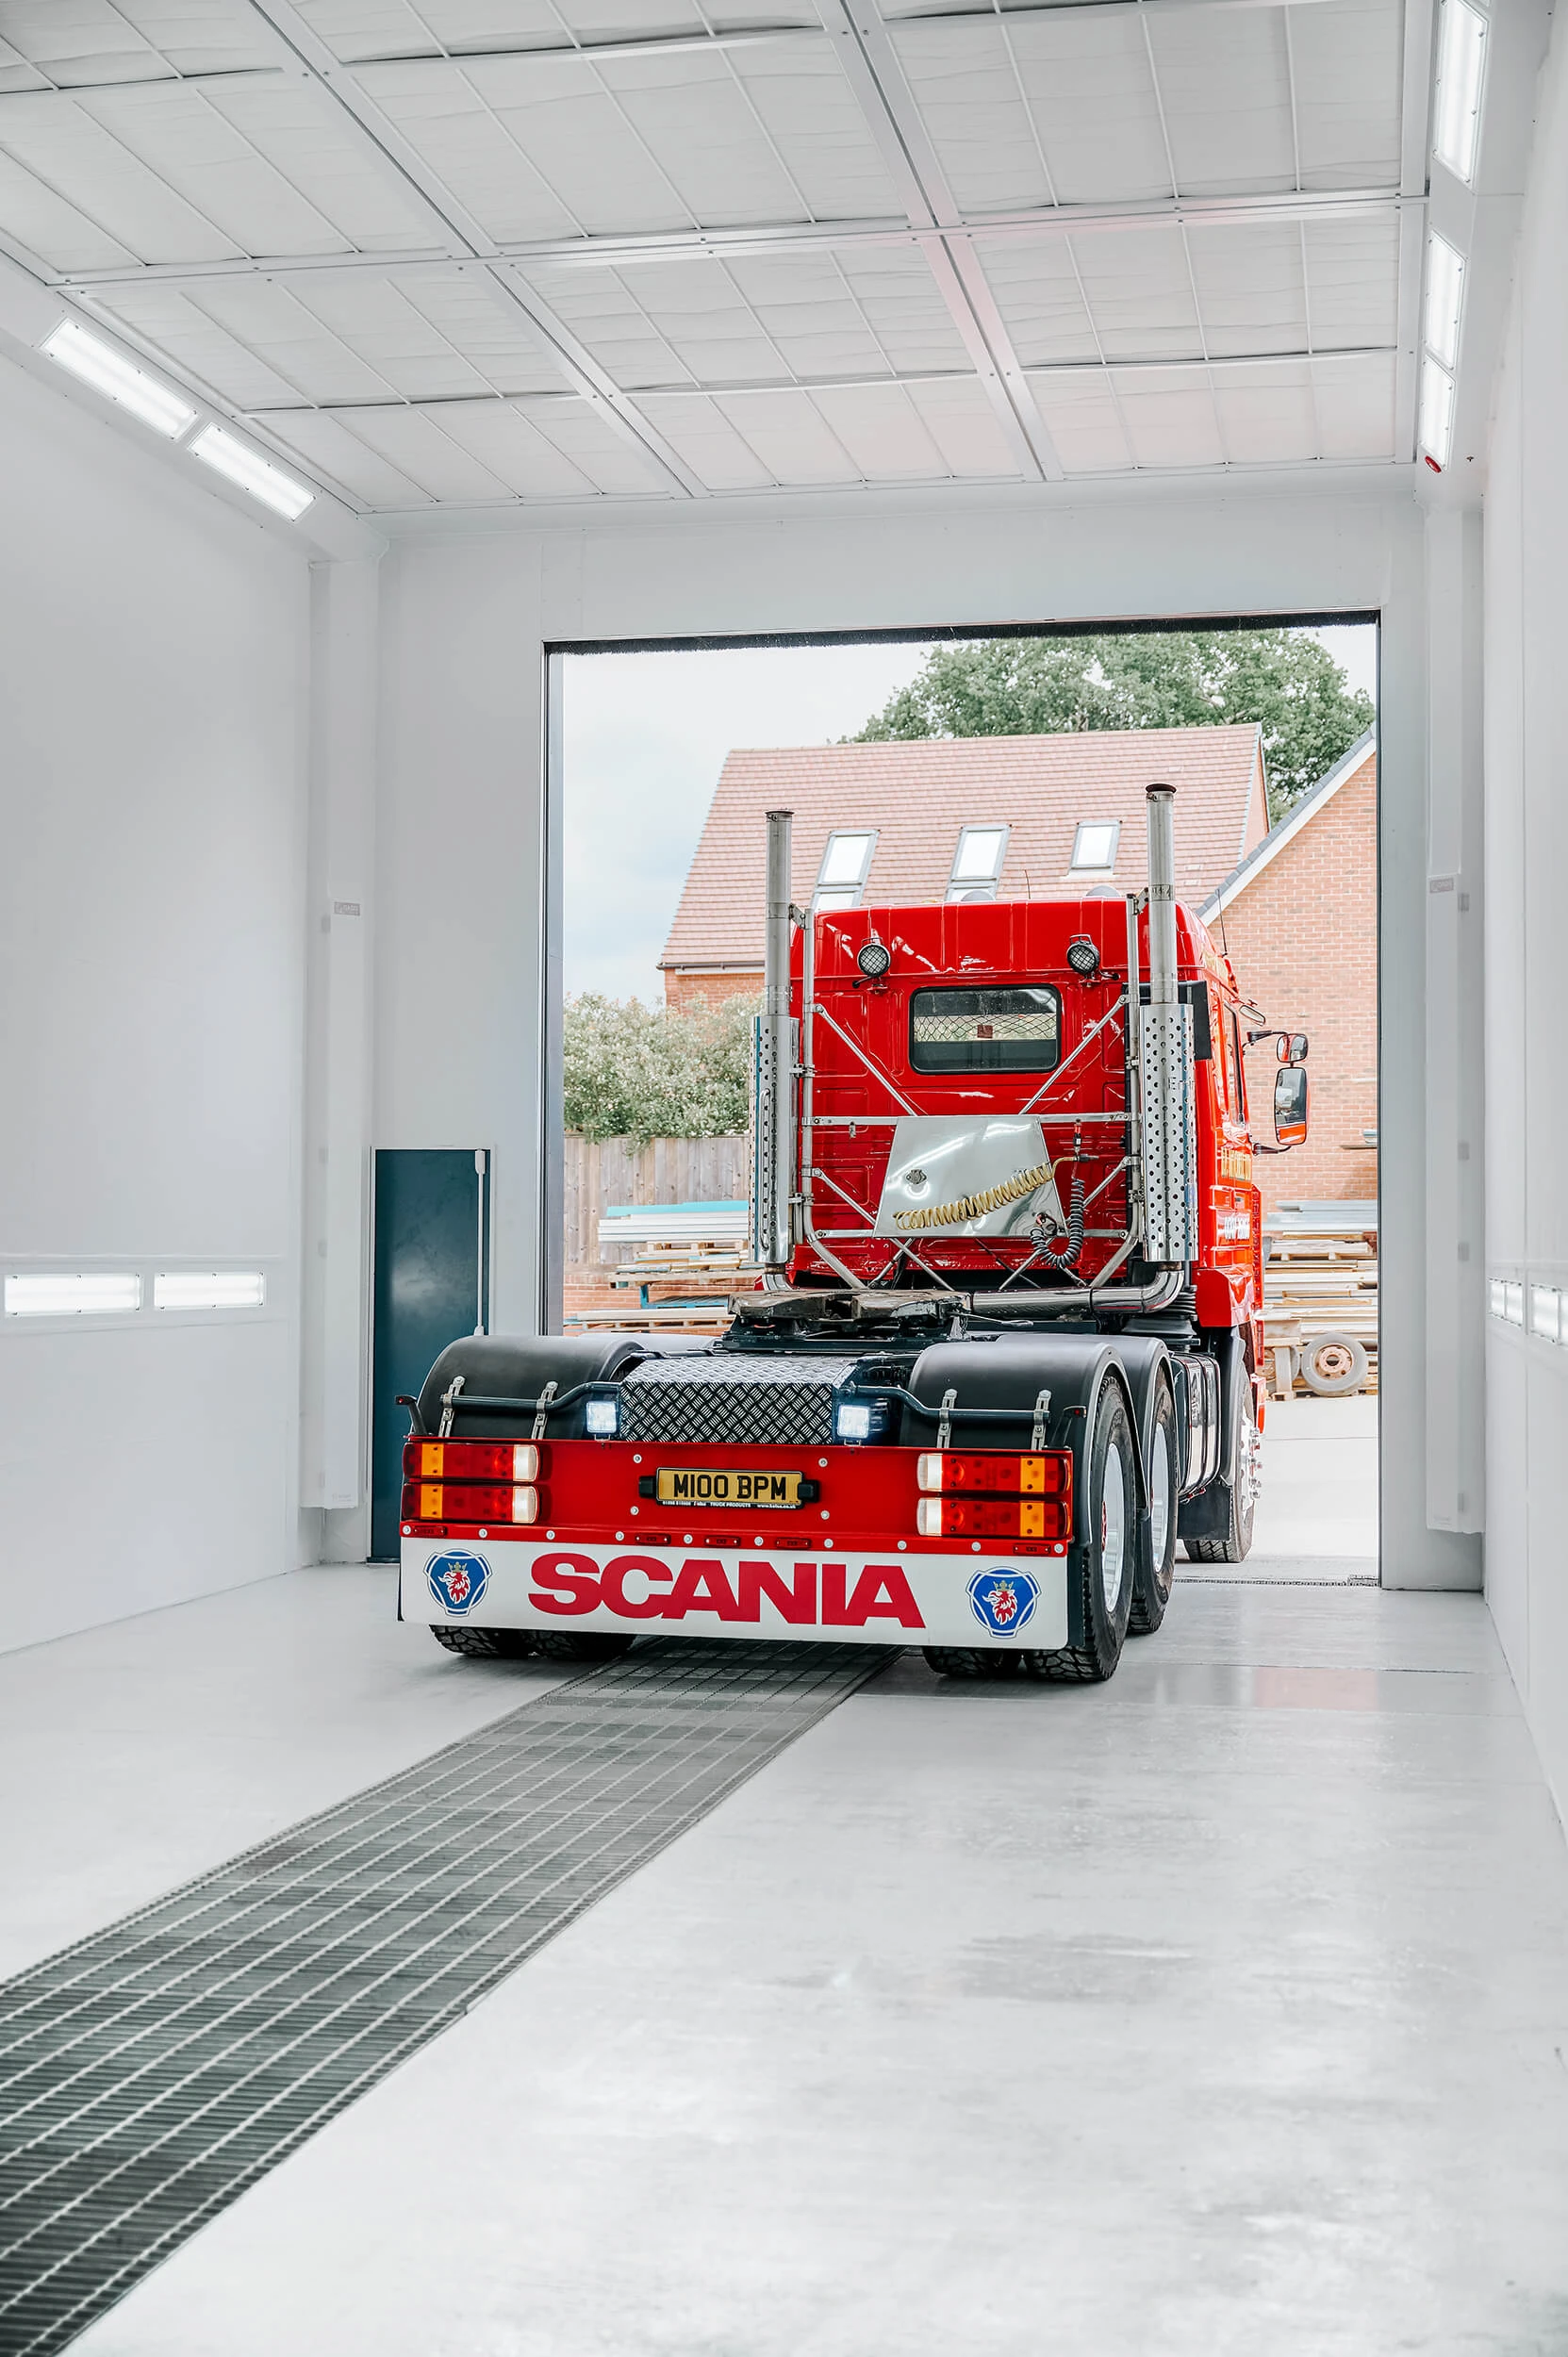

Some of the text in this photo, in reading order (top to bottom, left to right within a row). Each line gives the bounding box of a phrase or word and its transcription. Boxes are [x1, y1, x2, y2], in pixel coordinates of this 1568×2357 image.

[673, 1474, 786, 1501] M100 BPM
[527, 1550, 927, 1629] SCANIA
